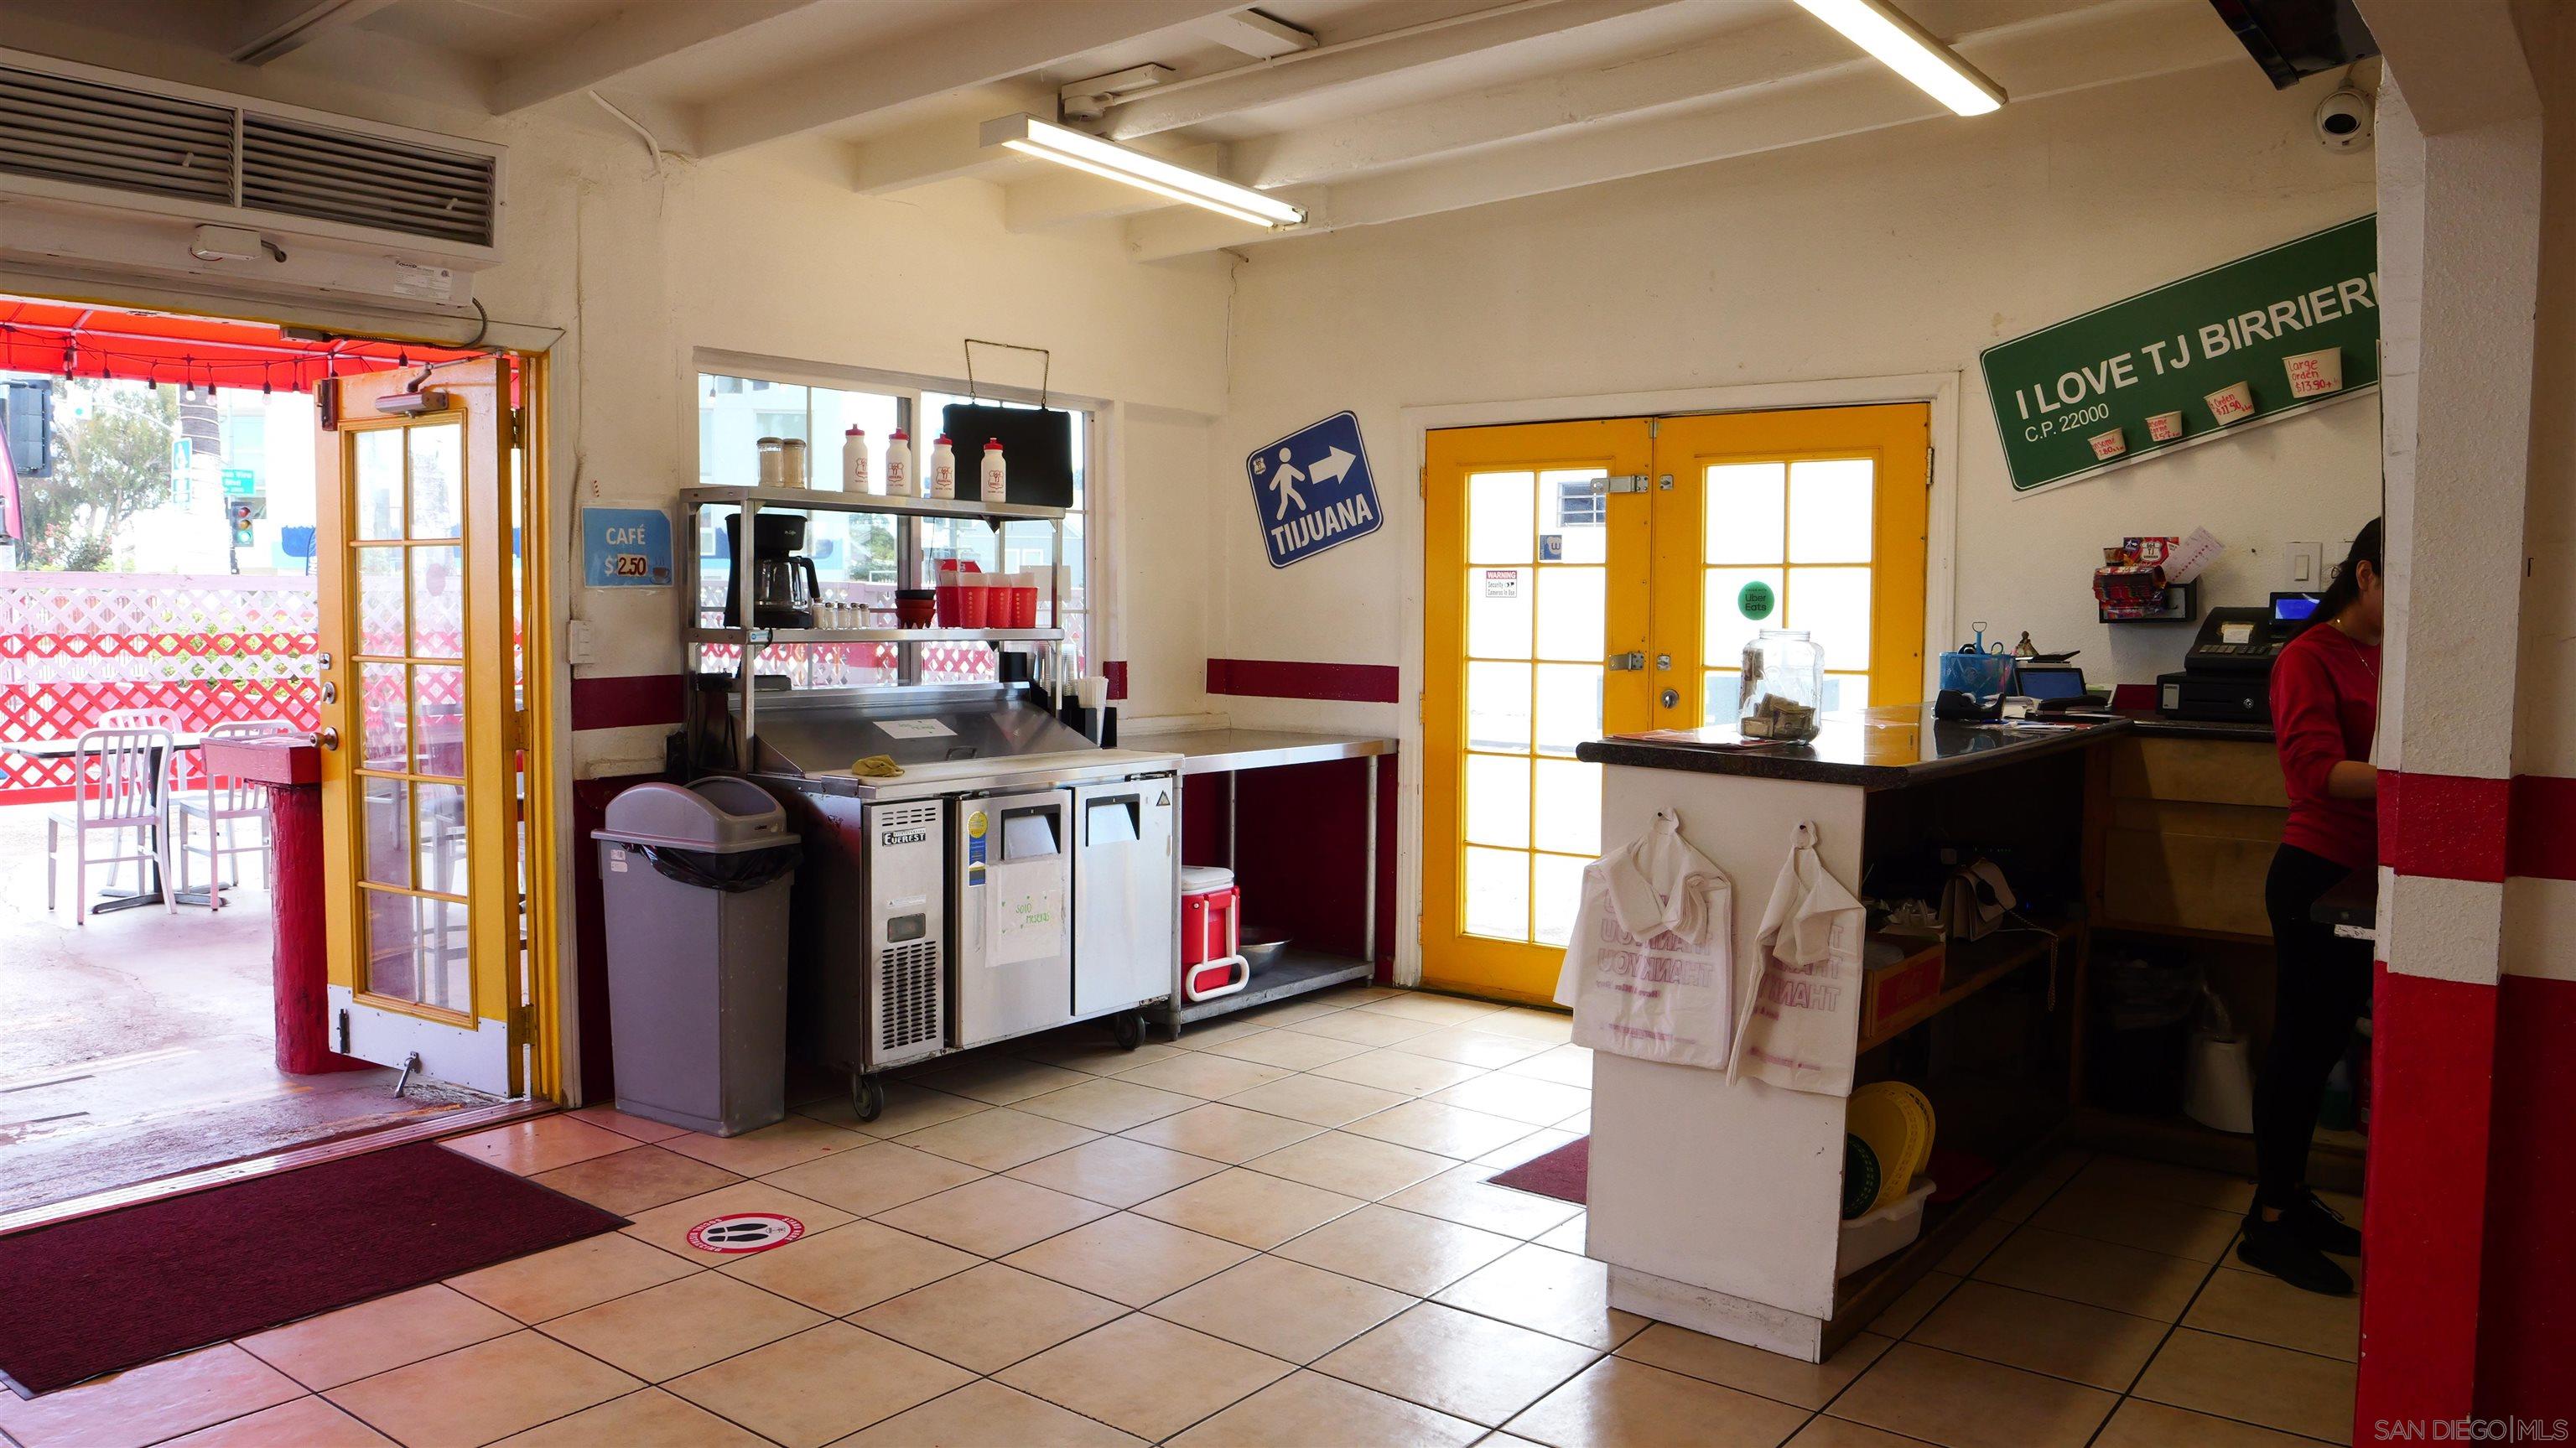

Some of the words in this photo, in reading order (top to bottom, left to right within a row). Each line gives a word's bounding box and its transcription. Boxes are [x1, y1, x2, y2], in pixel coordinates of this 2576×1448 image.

[2016, 390, 2029, 419] I
[2033, 352, 2138, 413] LOVE
[2141, 335, 2192, 376] TJ
[2025, 421, 2057, 442] C.P.
[2059, 403, 2109, 432] 22000
[606, 523, 646, 545] CAFÉ
[1488, 571, 1516, 579] WARNING
[1745, 594, 1766, 602] Uber
[1745, 603, 1767, 611] Eats
